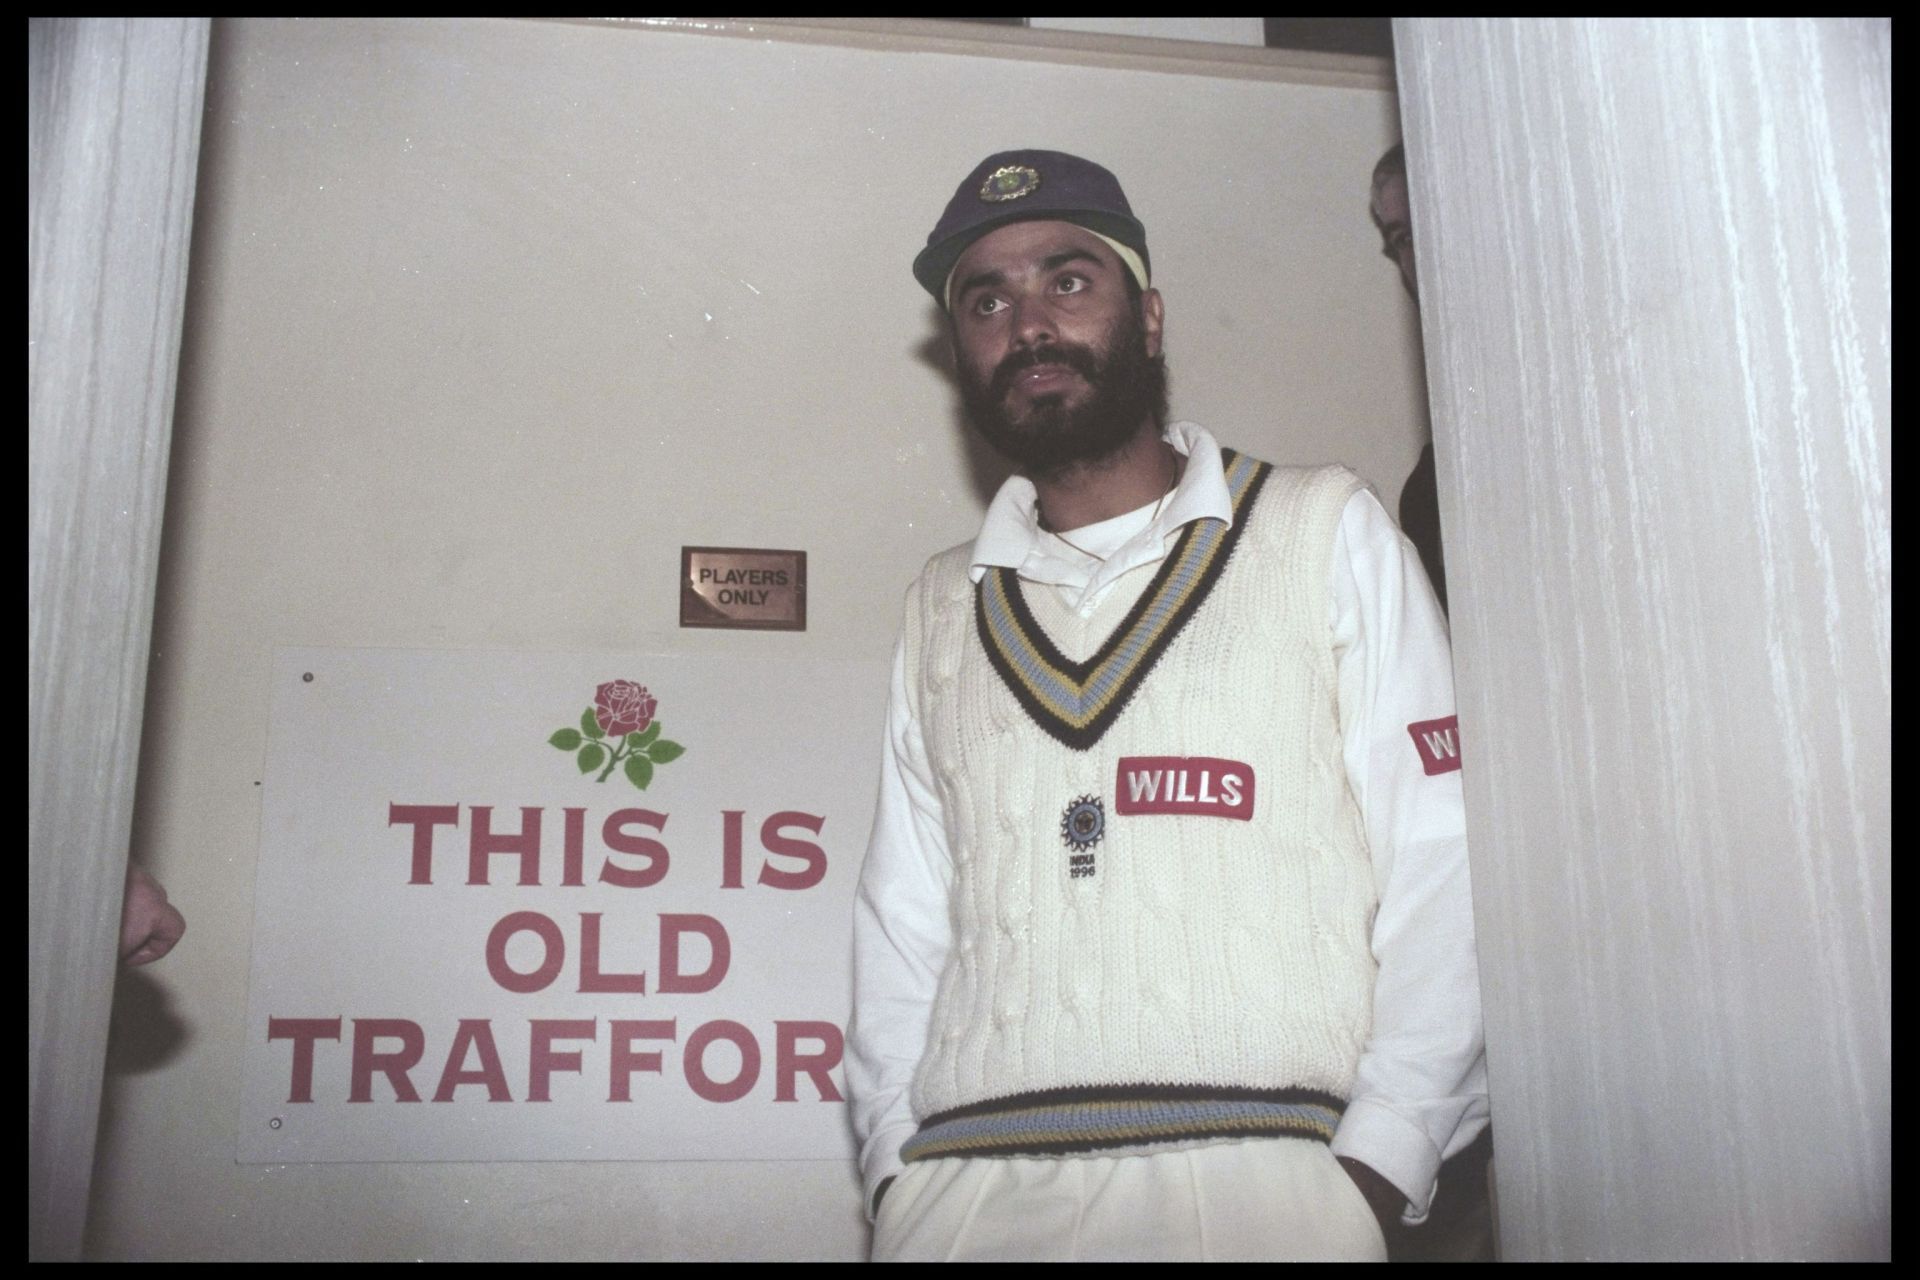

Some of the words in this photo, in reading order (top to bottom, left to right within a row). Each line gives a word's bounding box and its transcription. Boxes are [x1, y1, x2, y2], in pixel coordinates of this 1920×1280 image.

[699, 568, 789, 586] PLAYERS
[718, 589, 769, 606] ONLY
[1422, 727, 1459, 760] W
[1127, 770, 1243, 807] WILLS
[388, 801, 671, 888] THIS
[719, 810, 828, 891] IS
[1069, 854, 1096, 866] INDIA
[1069, 866, 1096, 879] 1996
[485, 911, 732, 996] OLD
